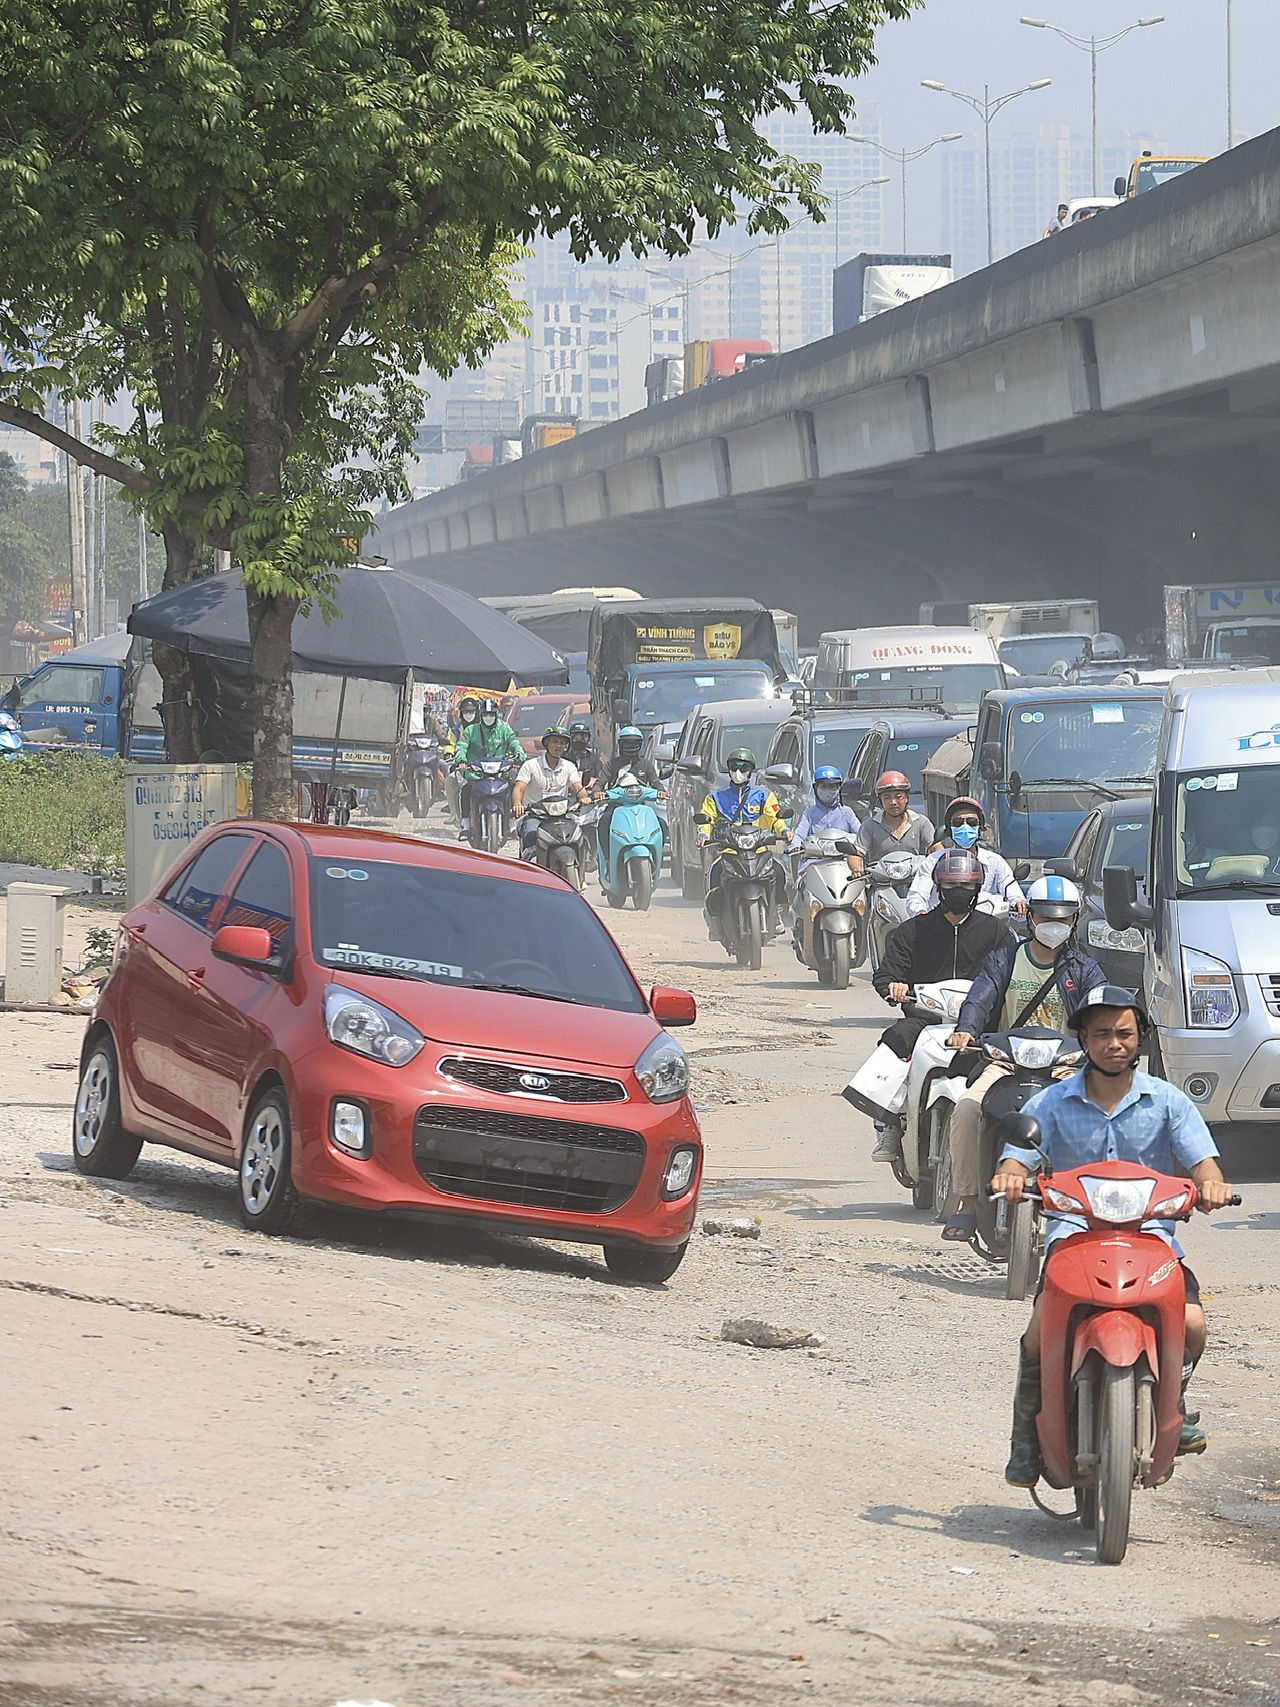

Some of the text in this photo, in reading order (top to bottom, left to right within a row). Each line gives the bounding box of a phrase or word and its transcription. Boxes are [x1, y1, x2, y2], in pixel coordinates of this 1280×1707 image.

[747, 804, 760, 814] be
[335, 951, 451, 976] 30K-842.19
[522, 1076, 548, 1088] KIA
